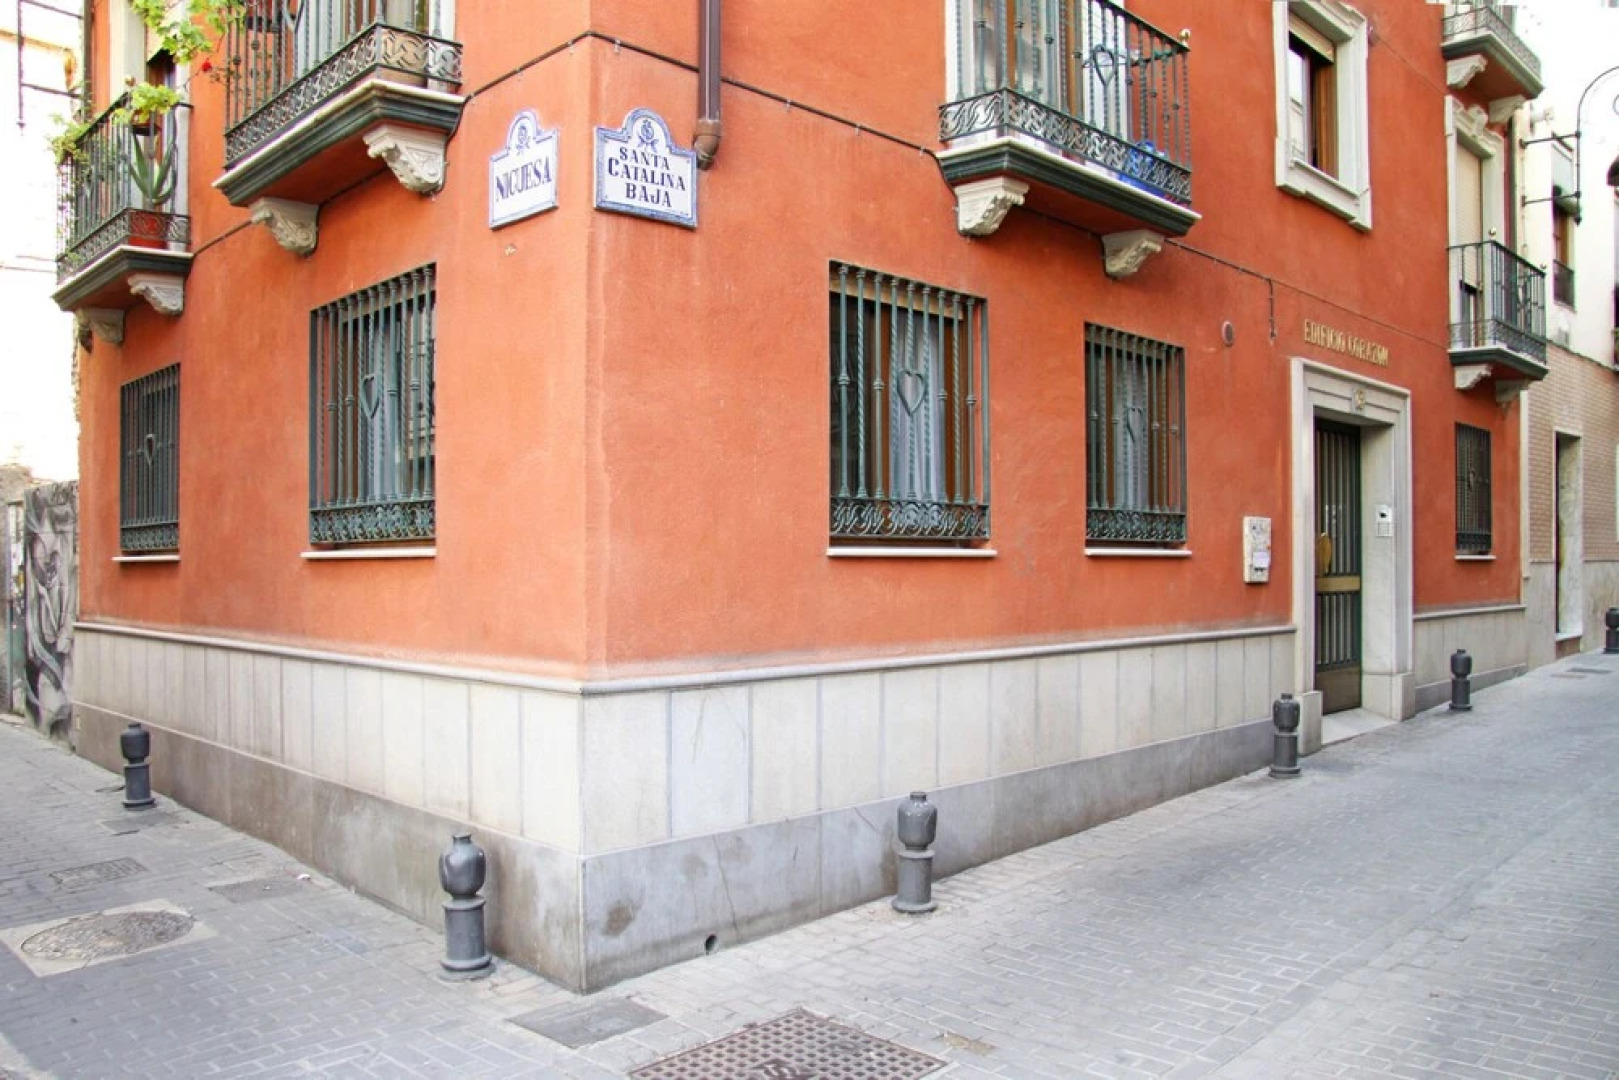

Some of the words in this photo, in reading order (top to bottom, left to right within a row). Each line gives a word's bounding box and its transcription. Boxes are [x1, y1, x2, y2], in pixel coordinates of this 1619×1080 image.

[607, 156, 686, 191] CATALINA
[619, 146, 670, 171] SANTA
[625, 182, 671, 208] BAJA
[1304, 318, 1345, 352] EDIFICIO
